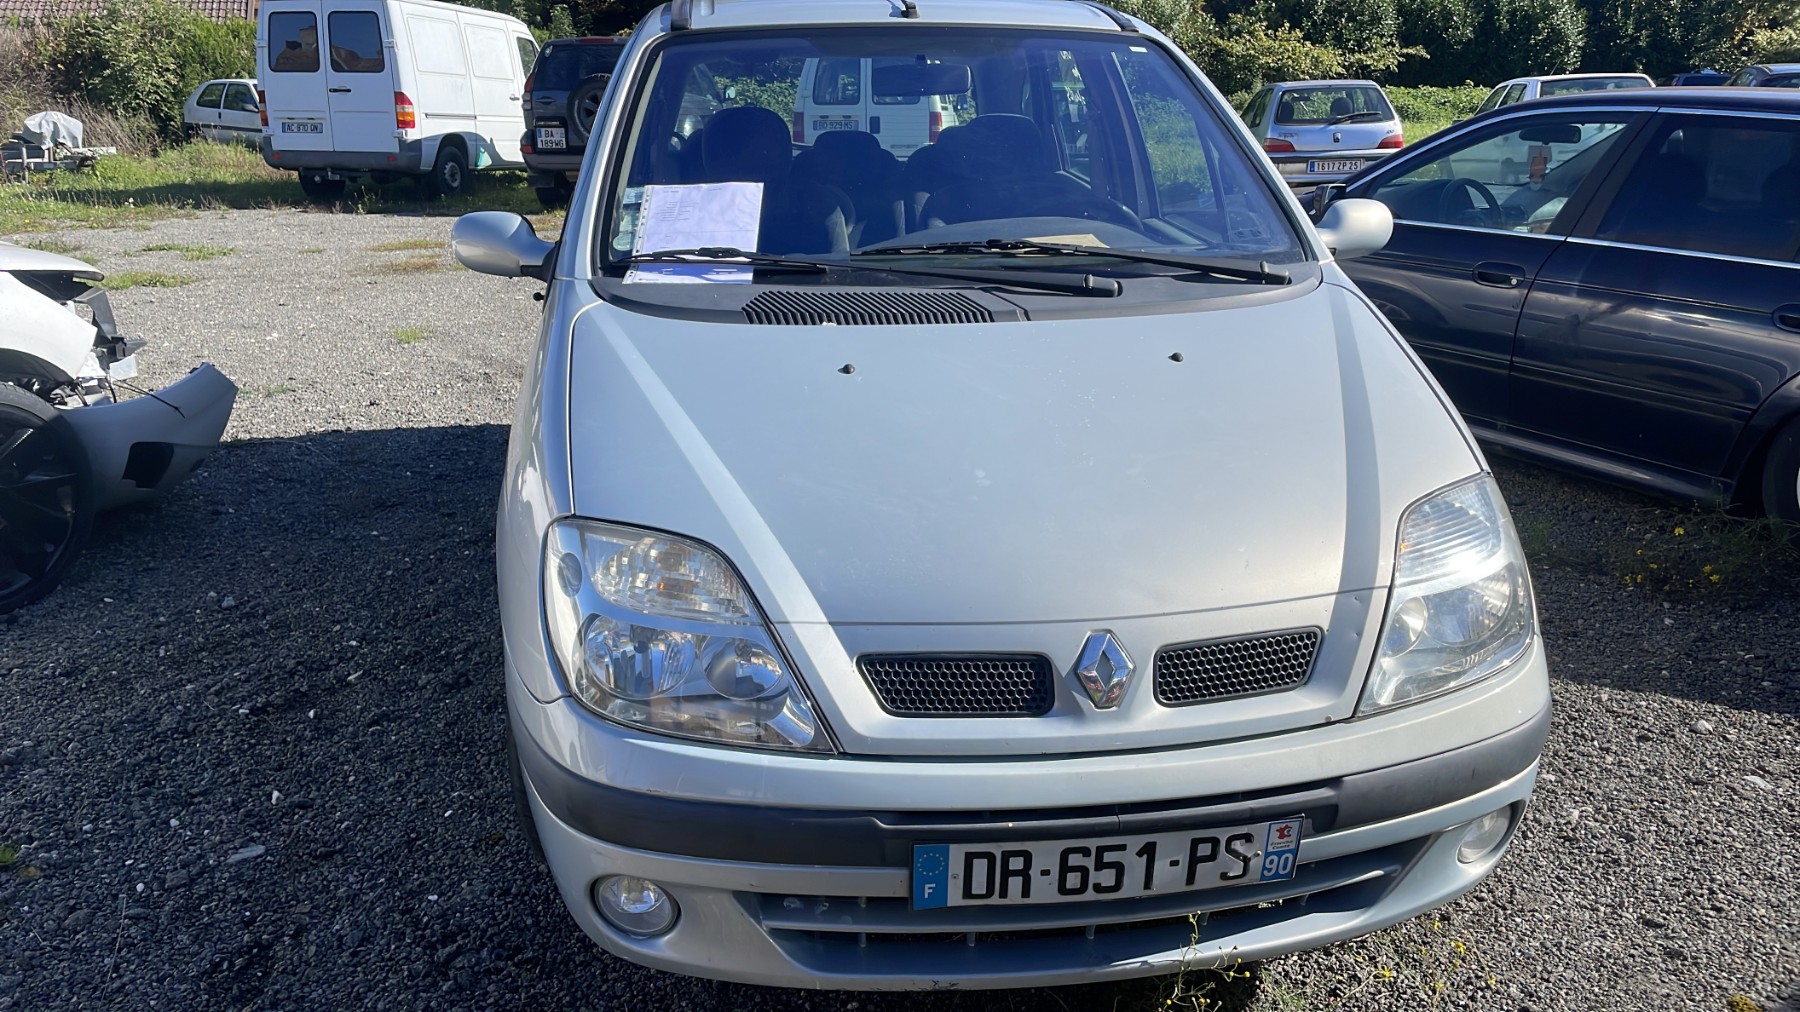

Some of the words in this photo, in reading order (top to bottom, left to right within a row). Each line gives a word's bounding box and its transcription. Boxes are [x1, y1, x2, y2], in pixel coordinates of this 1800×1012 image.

[1317, 162, 1336, 171] 1617
[1349, 161, 1359, 170] 25
[961, 832, 1255, 899] DR-651-PS
[1263, 853, 1293, 877] 90
[924, 883, 936, 899] F
